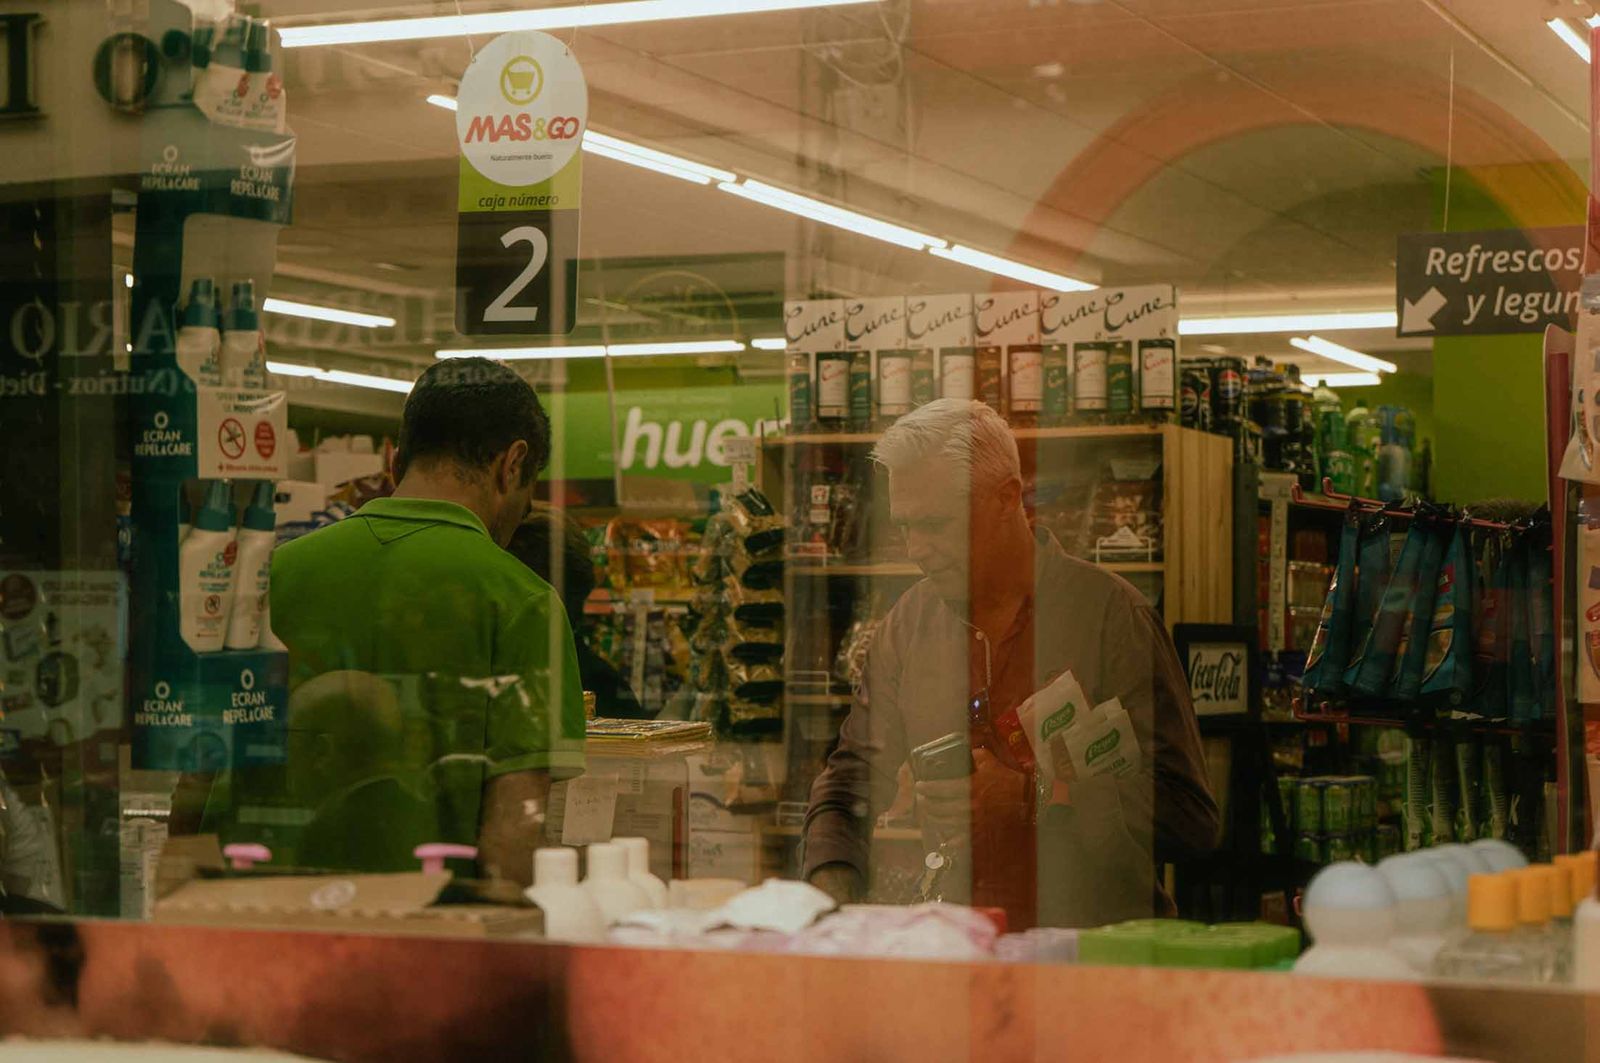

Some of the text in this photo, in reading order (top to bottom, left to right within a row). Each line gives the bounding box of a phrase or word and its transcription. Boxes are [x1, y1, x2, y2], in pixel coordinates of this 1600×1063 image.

[464, 113, 580, 143] MAS&GO
[478, 192, 559, 210] caja número
[482, 225, 549, 322] 2
[1462, 293, 1486, 325] y
[143, 430, 181, 442] ECRAN
[134, 442, 192, 457] REPEL&CARE
[144, 700, 183, 713] ECRAN
[231, 692, 265, 708] ECRAN
[135, 712, 192, 728] REPEL&CARE
[223, 706, 274, 725] REPEL&CARE
